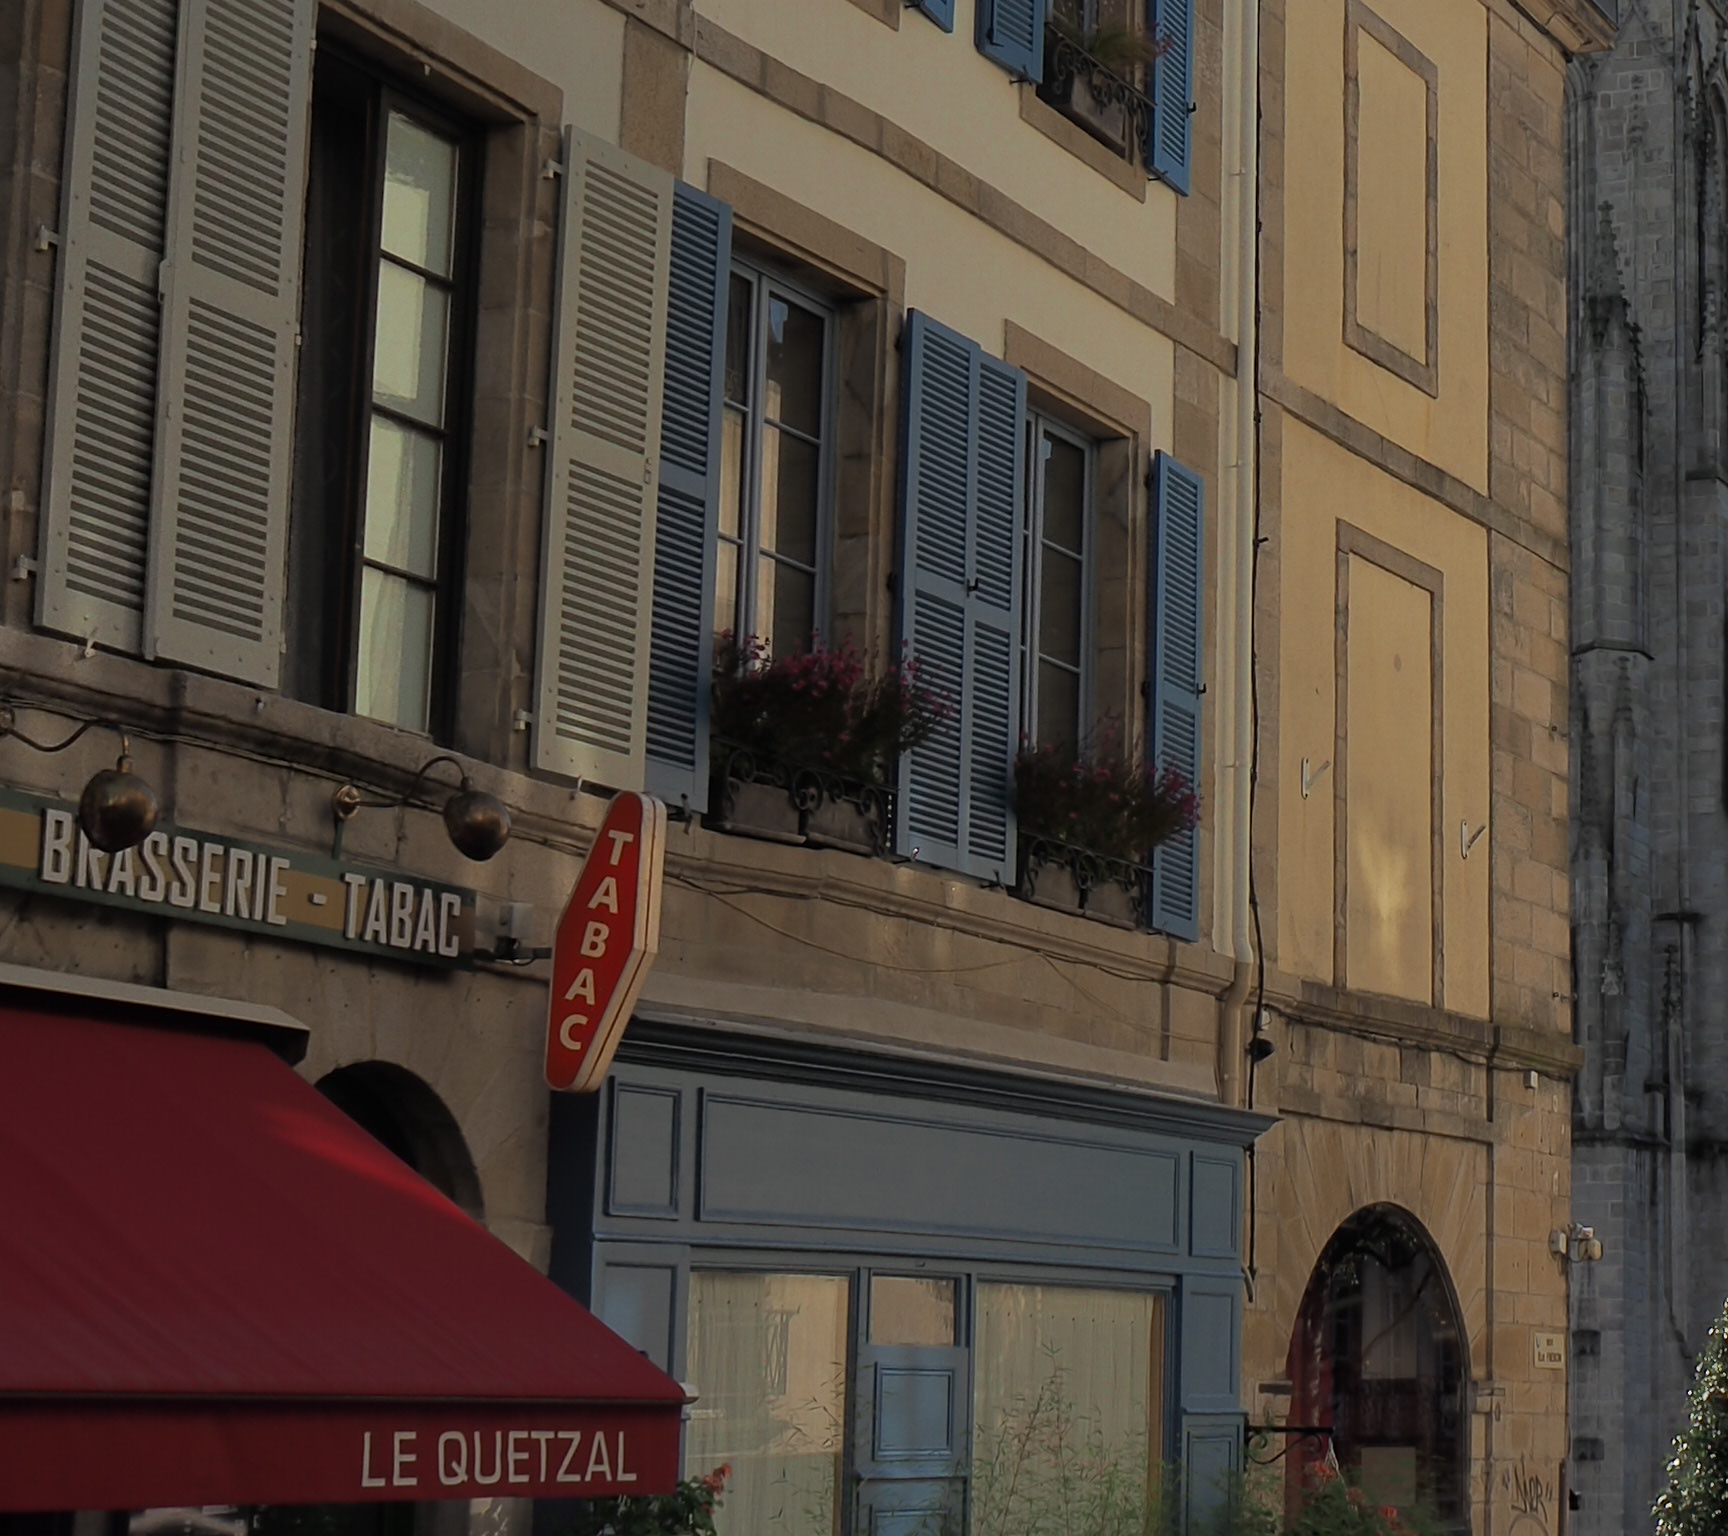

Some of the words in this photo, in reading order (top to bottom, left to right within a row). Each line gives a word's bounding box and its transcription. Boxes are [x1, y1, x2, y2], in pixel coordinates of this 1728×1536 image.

[40, 807, 291, 926] BRASSERIE
[343, 872, 463, 958] TABAC
[558, 828, 635, 1053] TABAC
[361, 1430, 419, 1489] LE
[437, 1429, 638, 1486] QUETZAL
